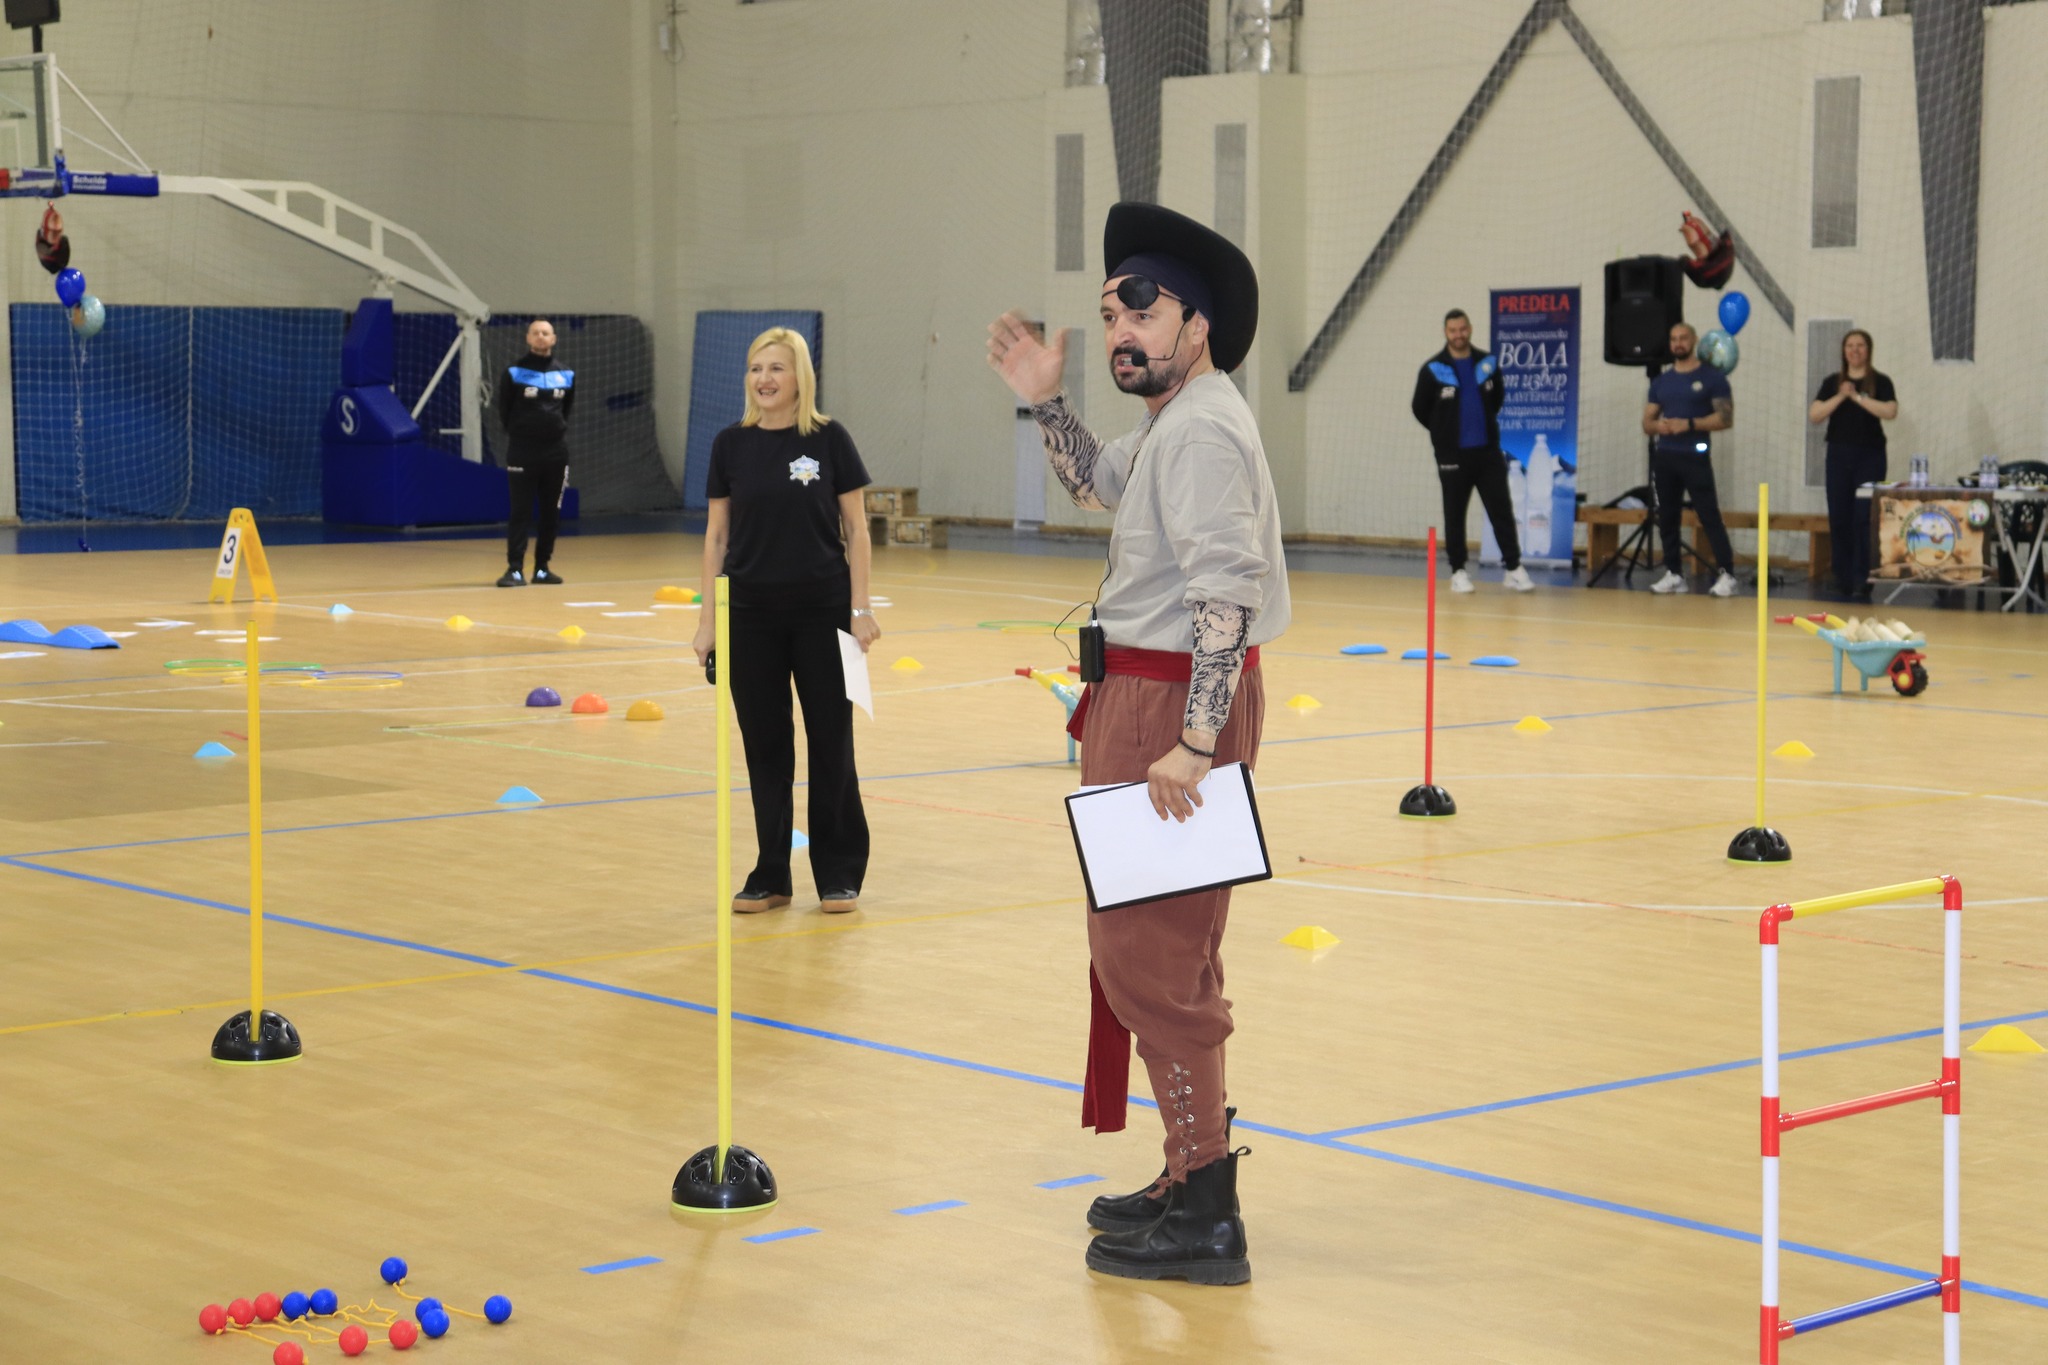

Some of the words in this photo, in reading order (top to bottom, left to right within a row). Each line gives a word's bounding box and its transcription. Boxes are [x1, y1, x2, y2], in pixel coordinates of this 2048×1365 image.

[1498, 294, 1570, 314] PREDELA
[1499, 341, 1568, 368] ВОДА
[1522, 364, 1567, 390] извор
[223, 535, 237, 564] 3
